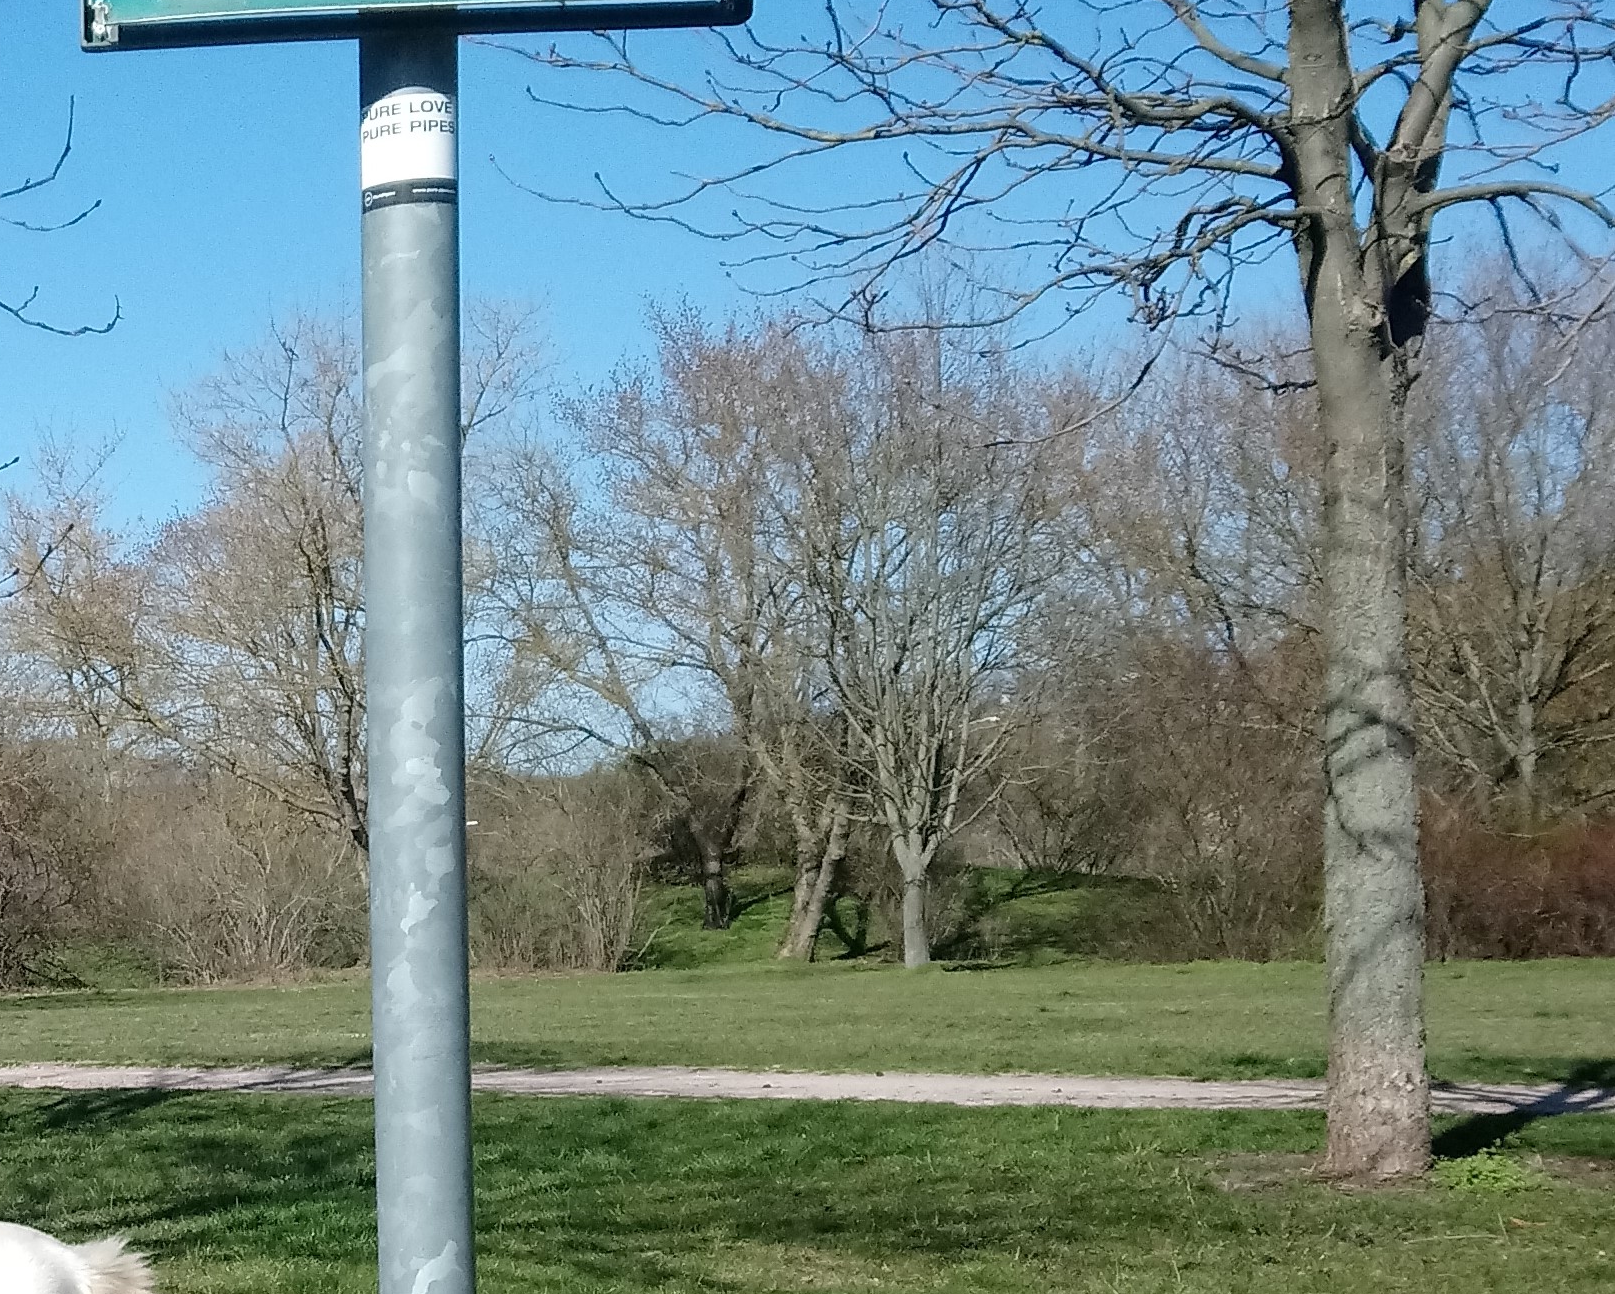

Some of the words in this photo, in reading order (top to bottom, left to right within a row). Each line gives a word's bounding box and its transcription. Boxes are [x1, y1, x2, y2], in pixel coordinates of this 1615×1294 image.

[363, 103, 401, 124] PURE
[410, 100, 452, 114] LOVE
[363, 123, 401, 143] PURE
[411, 120, 454, 134] PIPES
